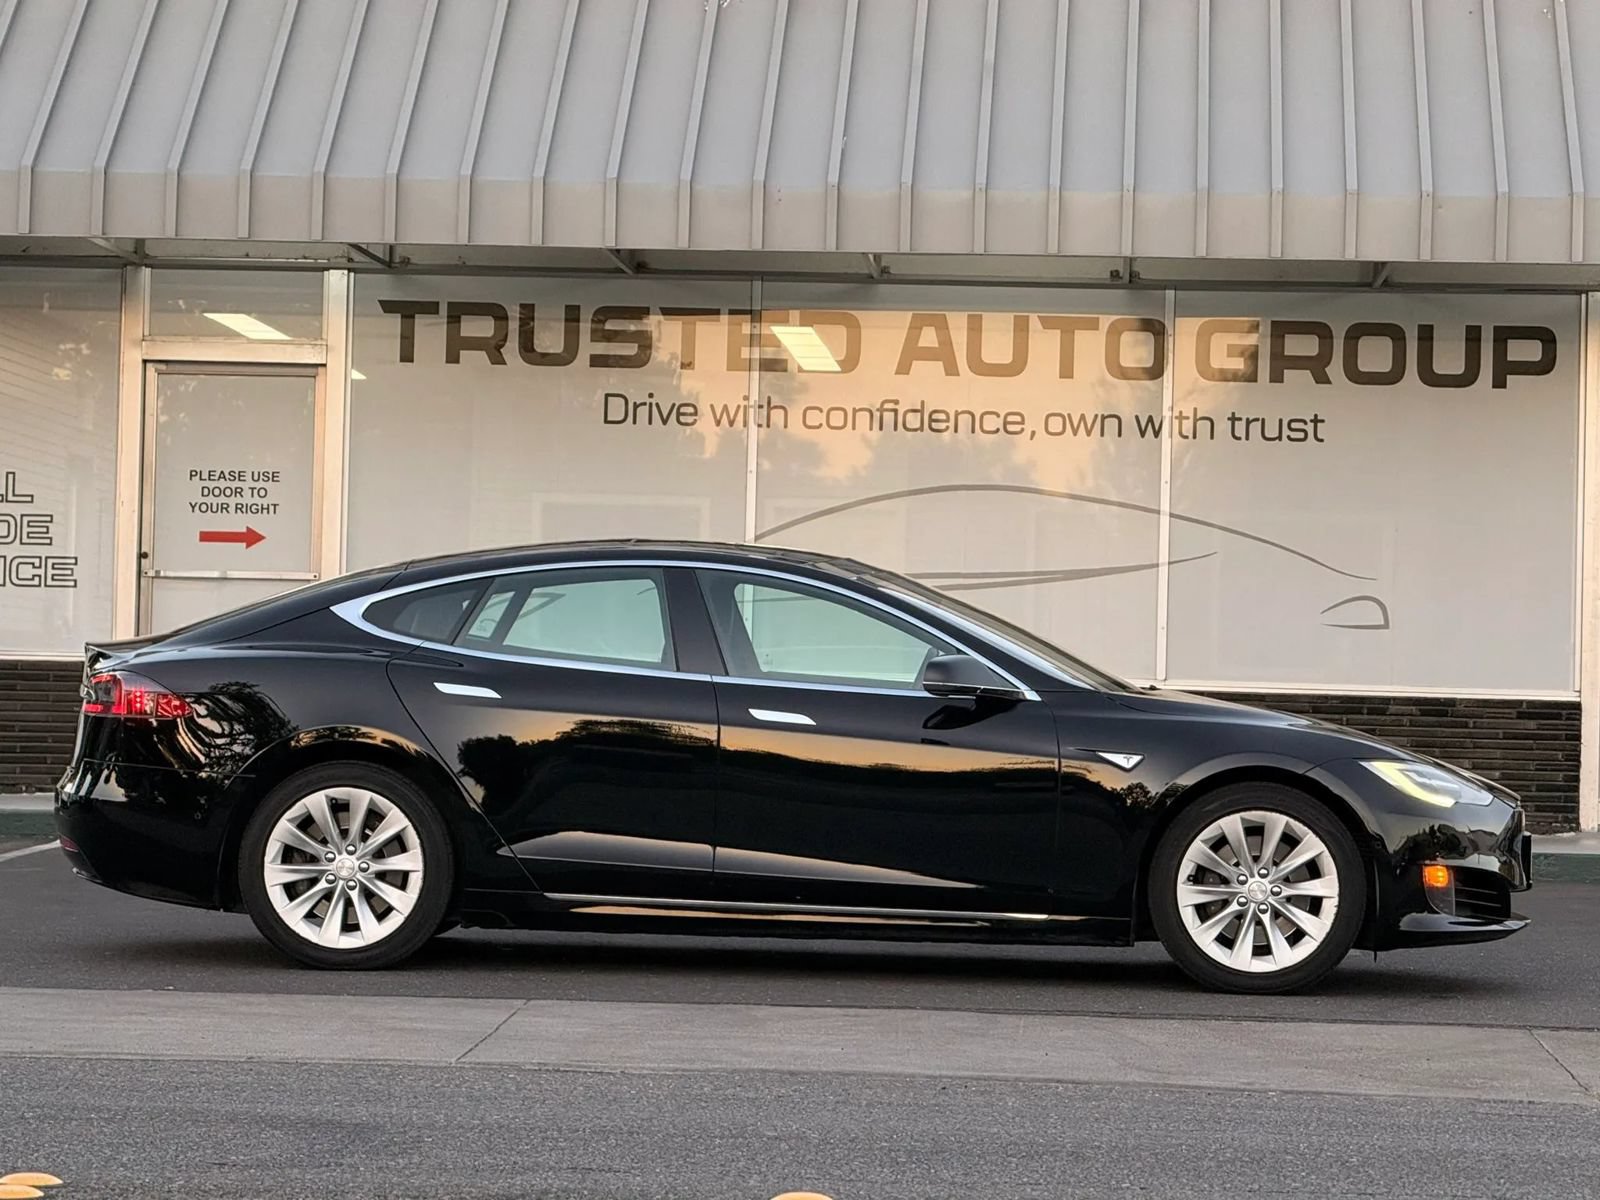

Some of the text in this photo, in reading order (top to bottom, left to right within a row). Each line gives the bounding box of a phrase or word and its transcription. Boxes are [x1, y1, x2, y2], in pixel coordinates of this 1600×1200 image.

[378, 299, 1557, 389] TRUSTED AUTO GROUP
[604, 393, 698, 429] Drive
[710, 395, 788, 430] with
[1134, 407, 1216, 442] with
[1226, 412, 1326, 443] trust
[0, 471, 34, 503] L
[189, 469, 281, 483] PLEASE USE
[201, 486, 268, 499] DOOR TO
[189, 502, 280, 515] YOUR RIGHT
